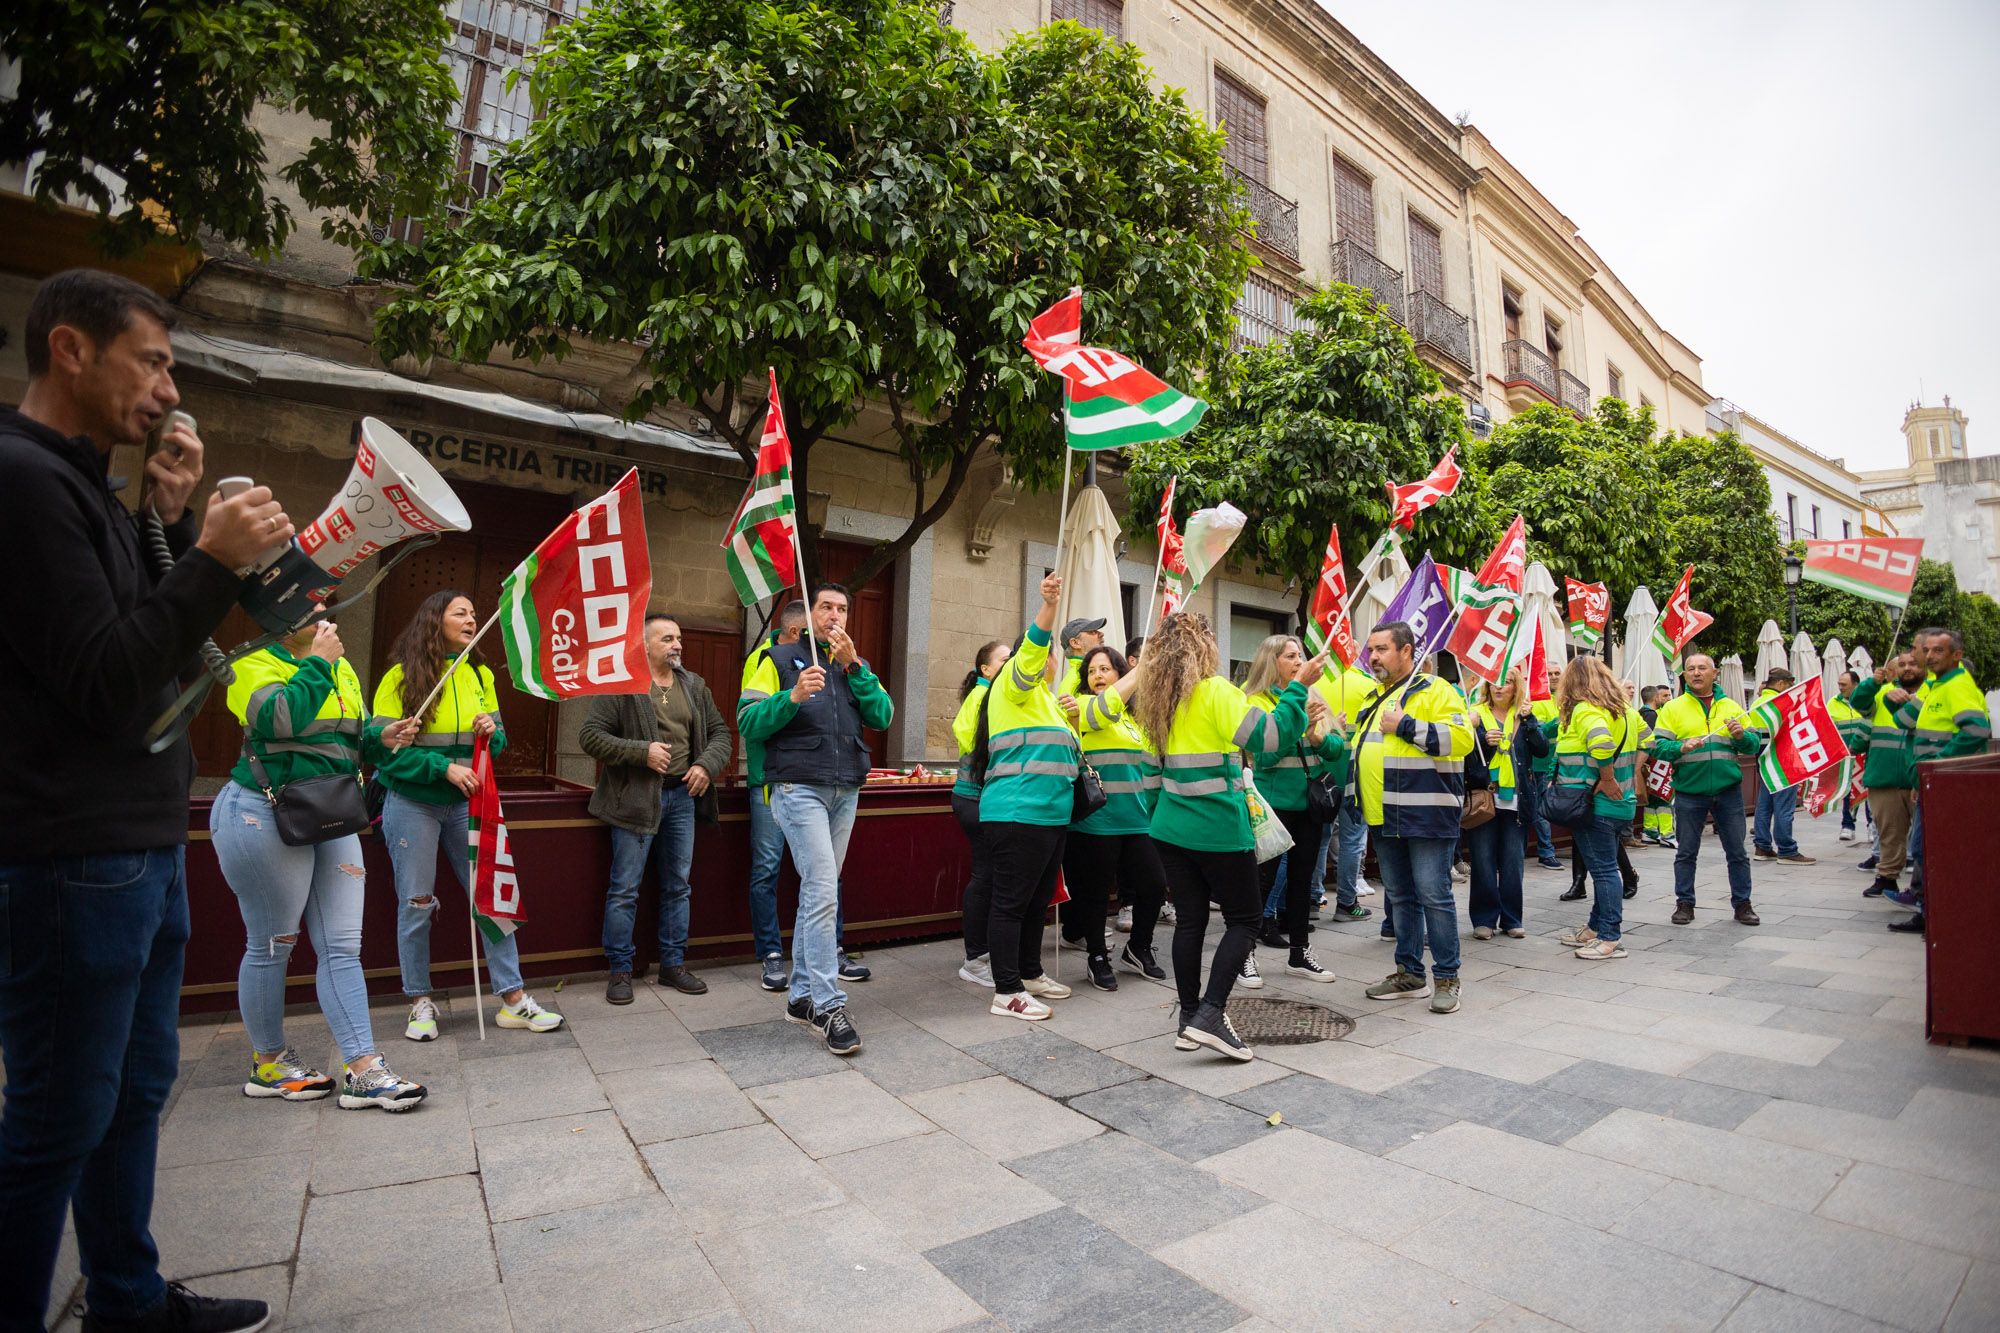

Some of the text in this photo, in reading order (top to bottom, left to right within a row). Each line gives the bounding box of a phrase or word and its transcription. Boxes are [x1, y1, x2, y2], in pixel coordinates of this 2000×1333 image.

[350, 420, 668, 496] RCERIA TRIBR
[575, 490, 634, 685] CCOO
[551, 608, 582, 692] Cádiz
